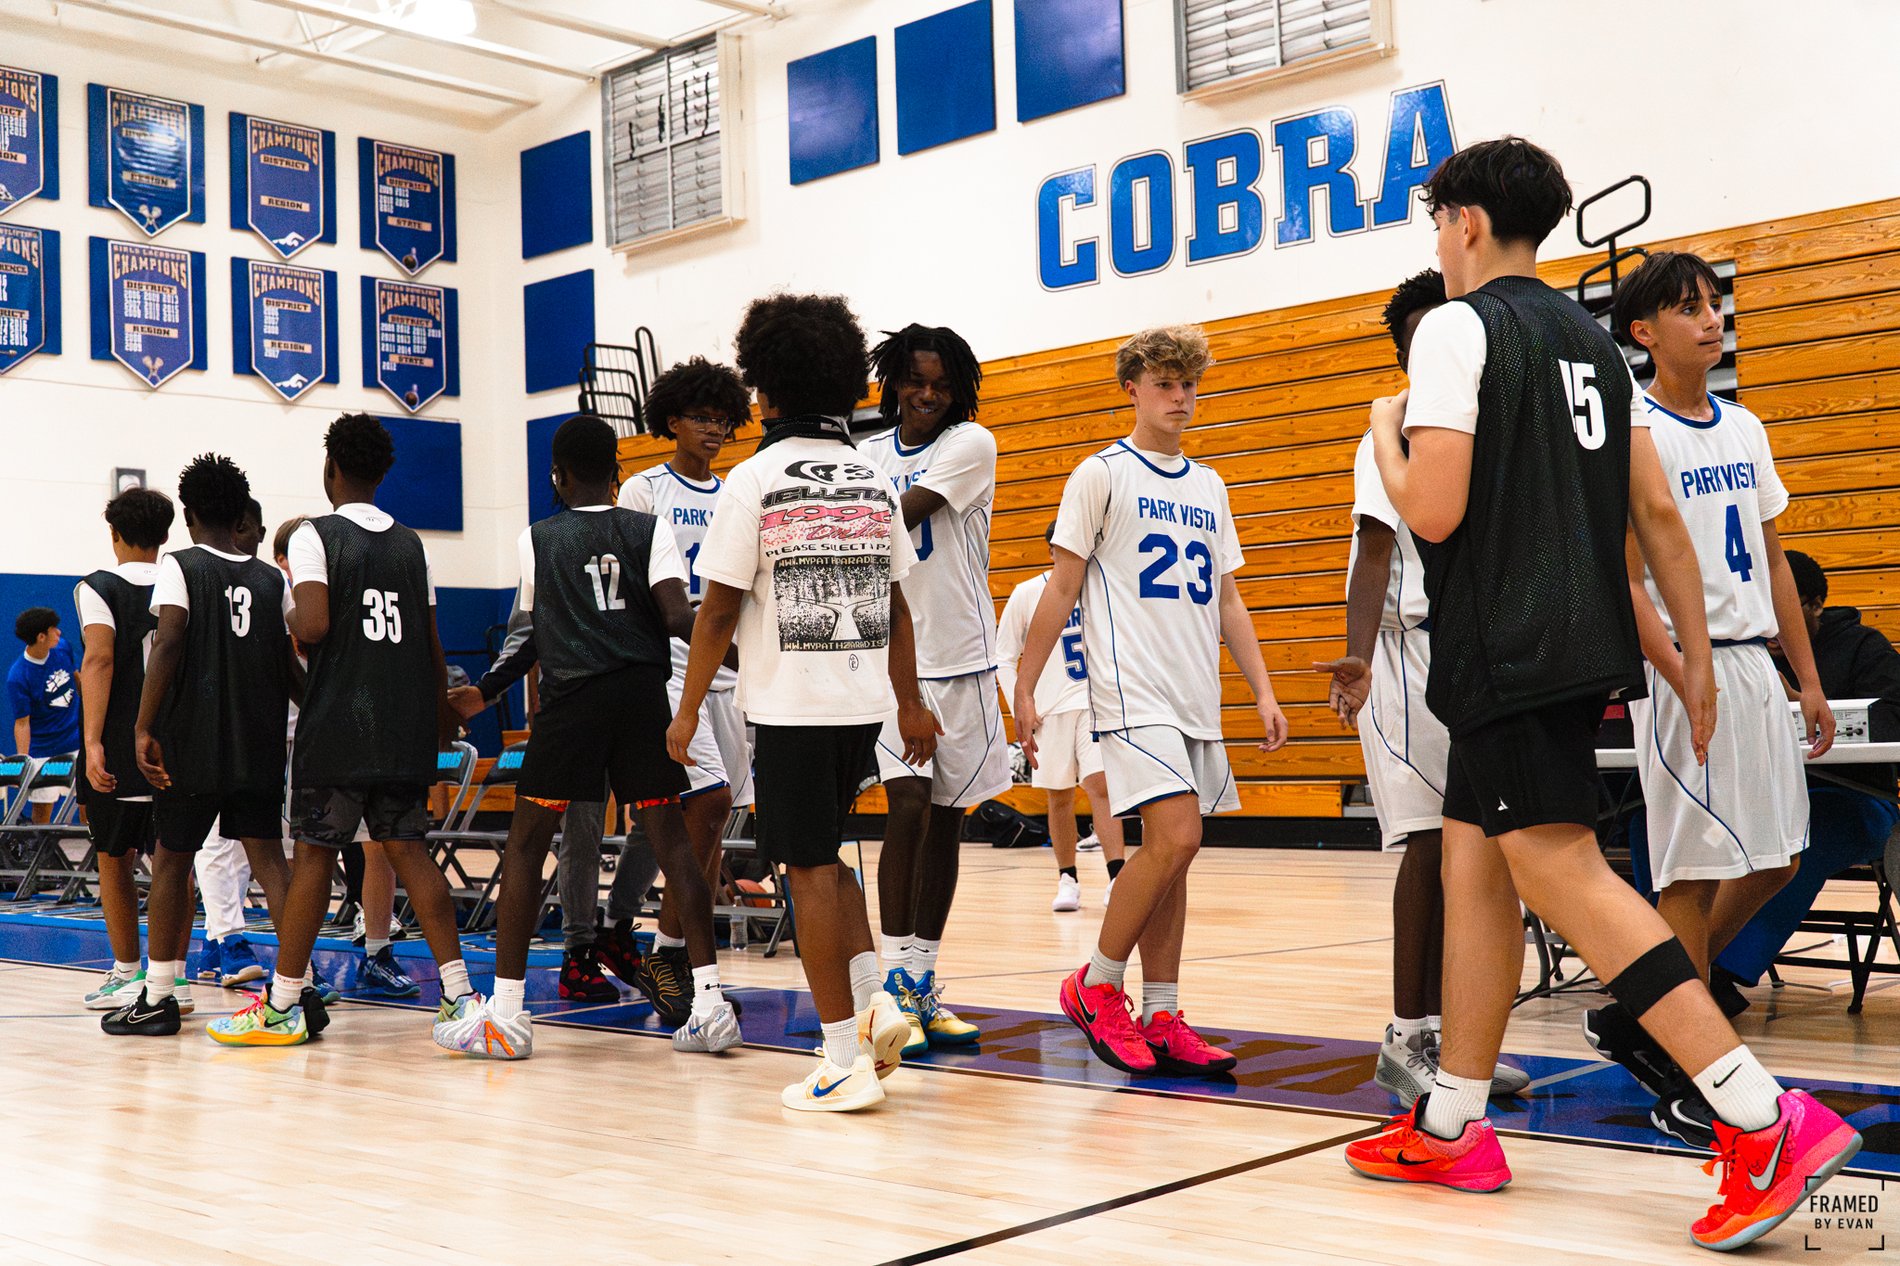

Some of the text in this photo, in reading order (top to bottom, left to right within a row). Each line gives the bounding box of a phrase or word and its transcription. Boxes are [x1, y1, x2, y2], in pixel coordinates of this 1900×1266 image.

[252, 129, 318, 166] CHAMPIONS
[263, 156, 306, 169] DISTRICT
[379, 153, 438, 187] CHAMPIONS
[389, 178, 428, 191] DISTRICT
[1035, 79, 1458, 293] COBRA
[268, 198, 303, 210] REGION
[396, 218, 422, 229] STATE
[114, 254, 187, 289] CHAMPIONS
[253, 264, 320, 280] GIRLS SWIMMING
[127, 281, 174, 294] DISTRICT
[254, 273, 320, 306] CHAMPIONS
[266, 299, 309, 311] DISTRICT
[381, 290, 441, 321] CHAMPIONS
[133, 325, 170, 336] REGION
[391, 316, 429, 327] DISTRICT
[271, 341, 305, 351] REGION
[398, 355, 424, 367] STATE
[1558, 358, 1606, 450] 15
[673, 507, 708, 527] PARK
[1138, 496, 1217, 533] PARK VISTA
[765, 544, 816, 557] PLEASE
[1725, 504, 1752, 582] 4
[584, 553, 626, 611] 12
[1138, 533, 1213, 606] 23
[224, 585, 252, 638] 13
[362, 588, 402, 644] 35
